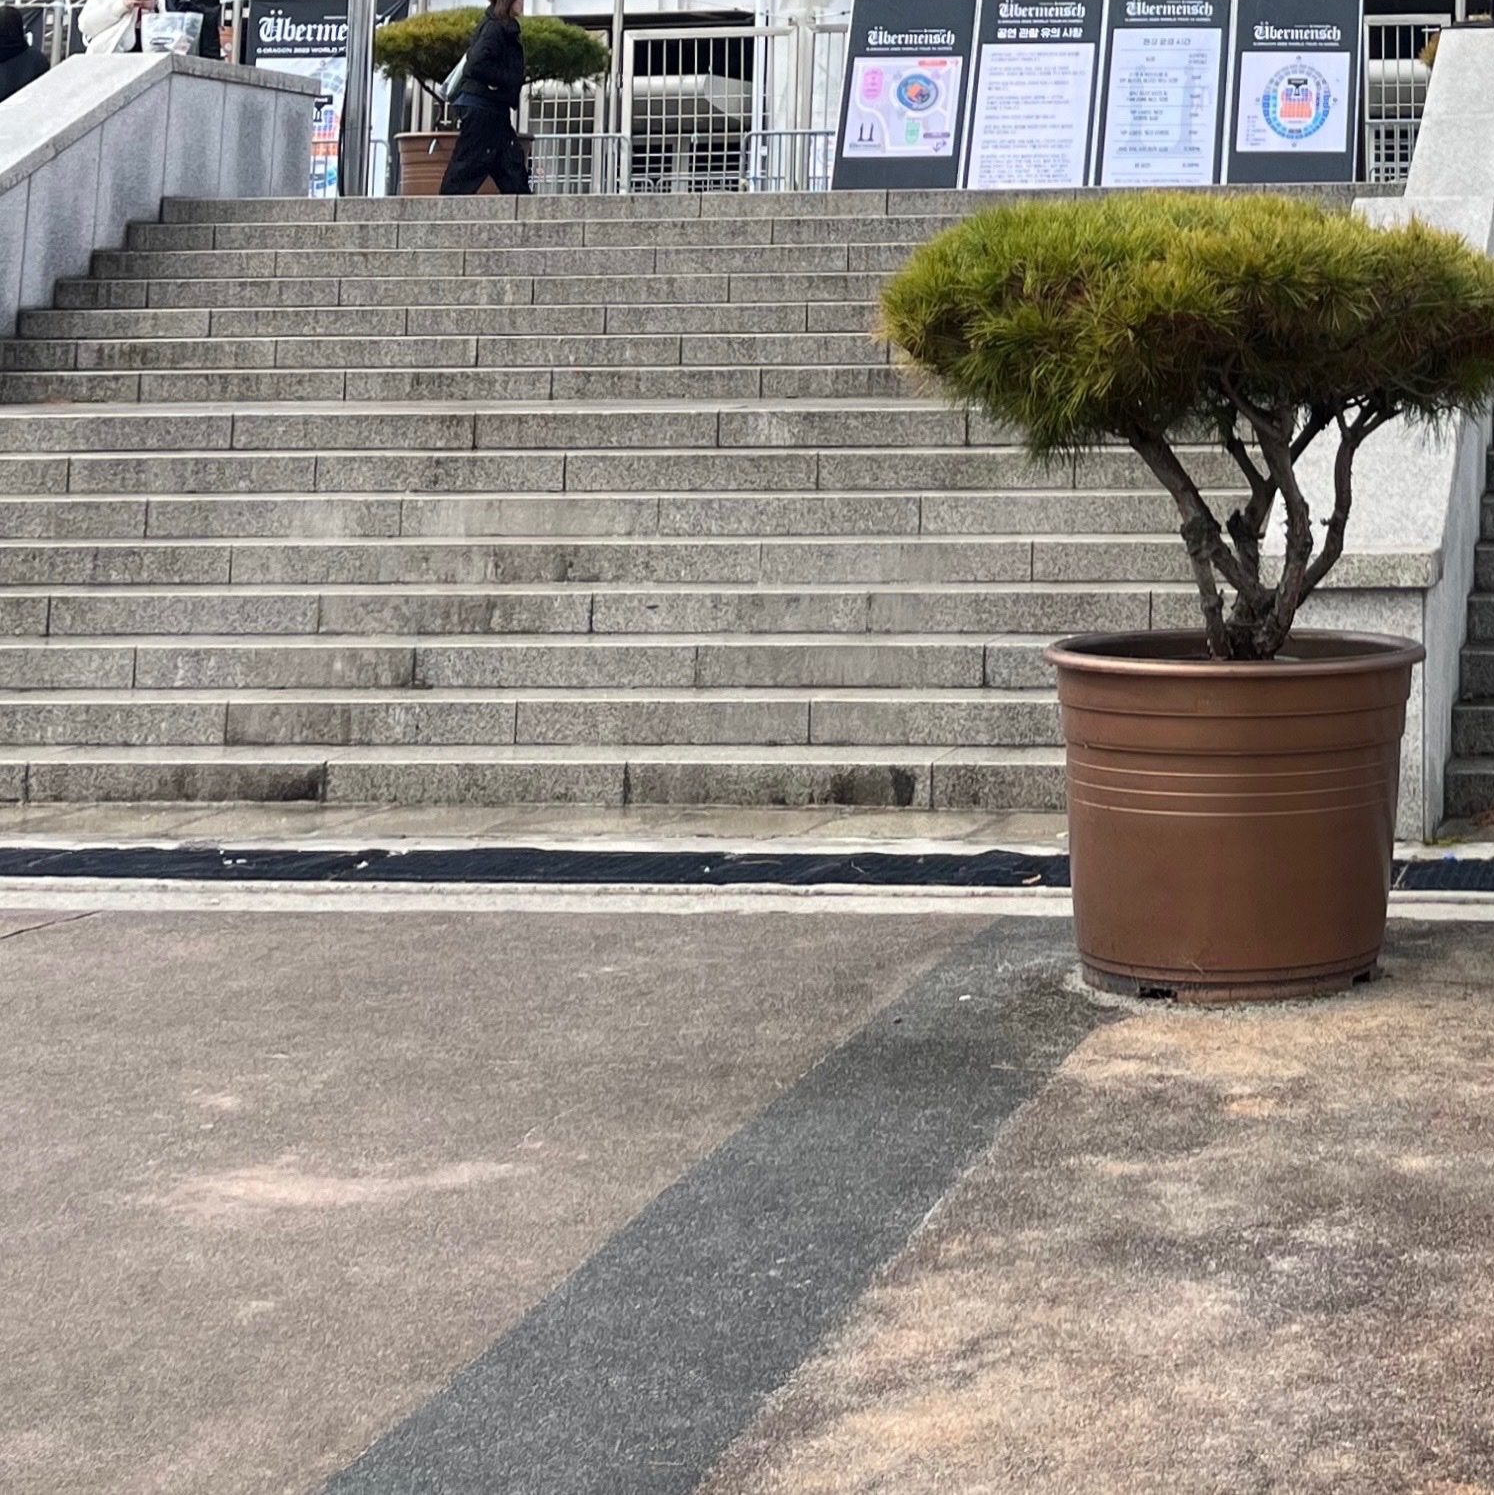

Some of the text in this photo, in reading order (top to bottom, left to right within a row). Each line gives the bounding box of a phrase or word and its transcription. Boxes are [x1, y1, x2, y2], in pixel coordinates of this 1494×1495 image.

[999, 0, 1086, 19] Übermensch
[258, 9, 349, 43] Überme
[867, 26, 956, 46] Übermensch
[1253, 20, 1342, 41] Übermensch
